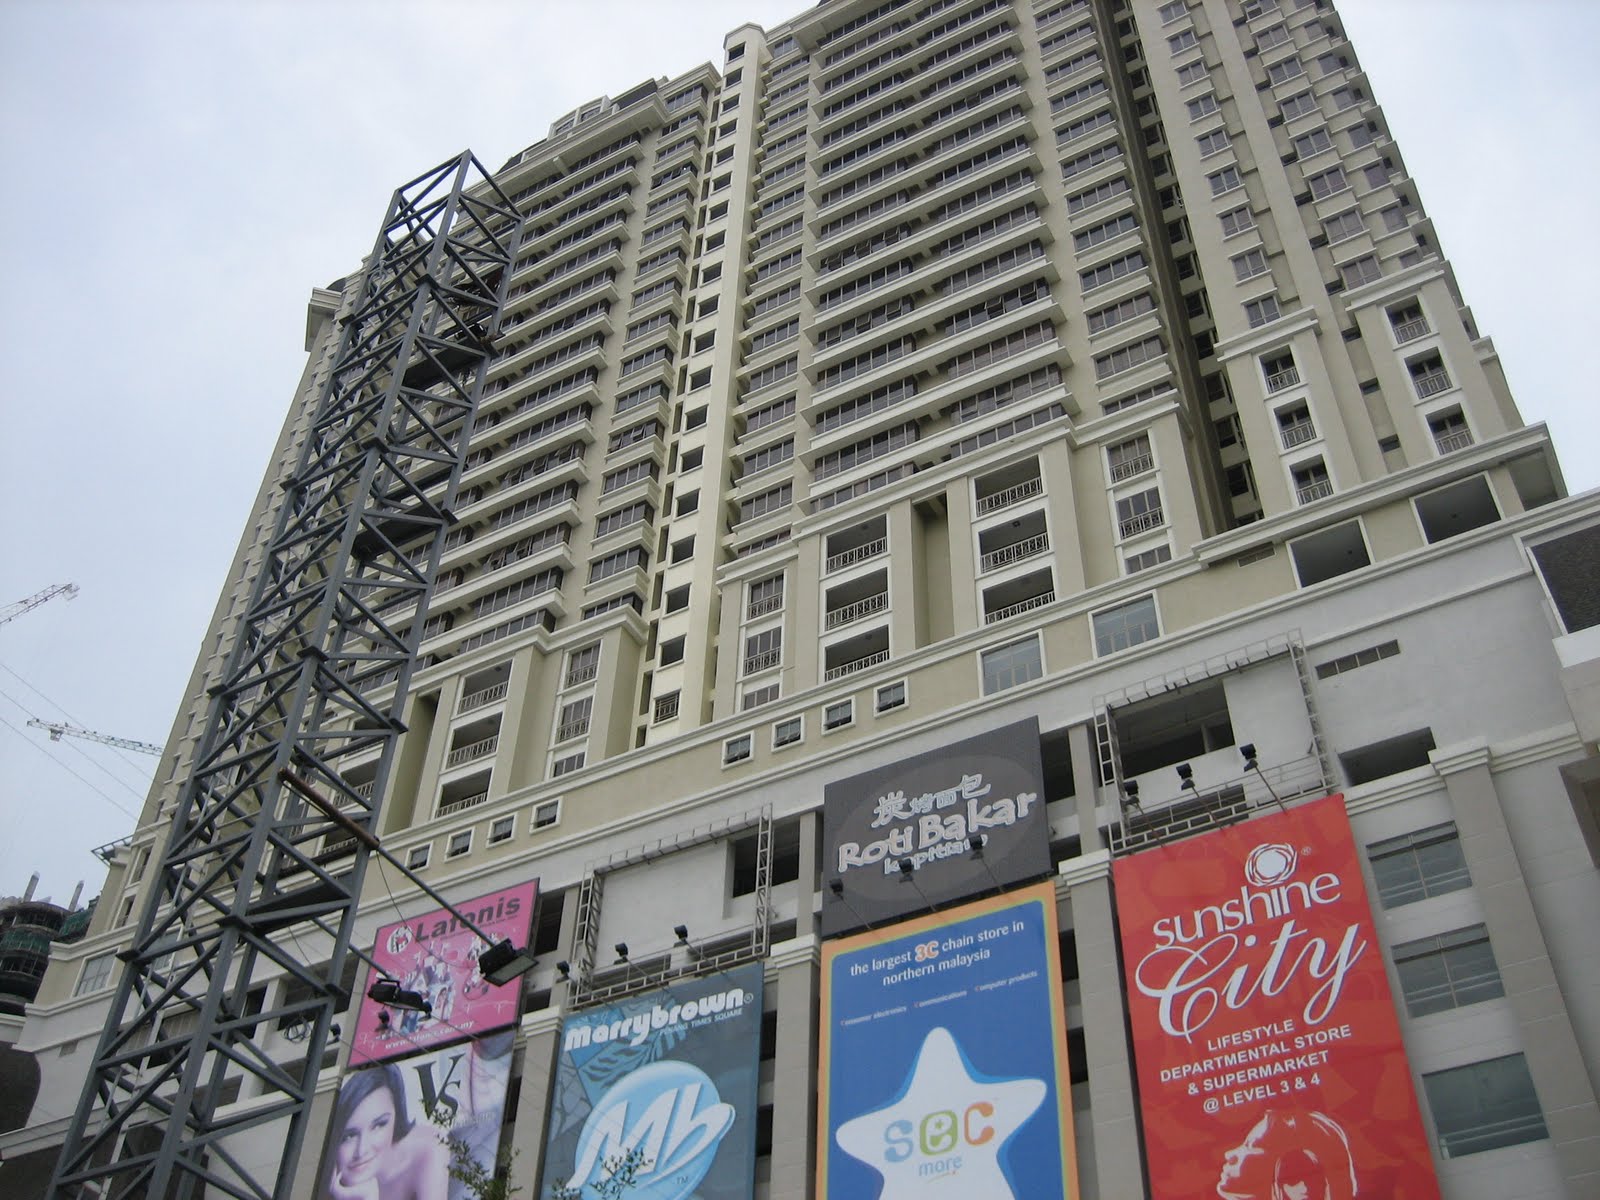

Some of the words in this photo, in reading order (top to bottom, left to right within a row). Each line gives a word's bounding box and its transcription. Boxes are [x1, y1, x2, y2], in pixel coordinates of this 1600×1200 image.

[838, 825, 914, 873] Roti
[918, 792, 1037, 849] Bakar
[1153, 872, 1342, 950] sunshine
[850, 963, 869, 977] the
[872, 952, 912, 972] largest
[914, 940, 939, 962] 3C
[942, 934, 974, 952] chain
[977, 926, 1009, 942] store
[1012, 920, 1025, 933] in
[882, 964, 935, 987] northern
[938, 949, 991, 972] malaysia
[1135, 919, 1367, 1044] City
[564, 988, 744, 1052] marrybrown
[714, 1008, 743, 1022] SQUARE
[1207, 1019, 1295, 1051] LIFESTYLE
[1160, 1040, 1290, 1082] DEPARTMENTAL
[1295, 1024, 1352, 1050] STORE
[1187, 1082, 1199, 1095] &
[1203, 1050, 1329, 1092] SUPERMARKET
[1203, 1097, 1220, 1114] @
[1223, 1084, 1276, 1107] LEVEL
[1281, 1080, 1291, 1093] 3
[1294, 1075, 1307, 1090] &
[1311, 1072, 1321, 1086] 4
[918, 1154, 963, 1177] more
